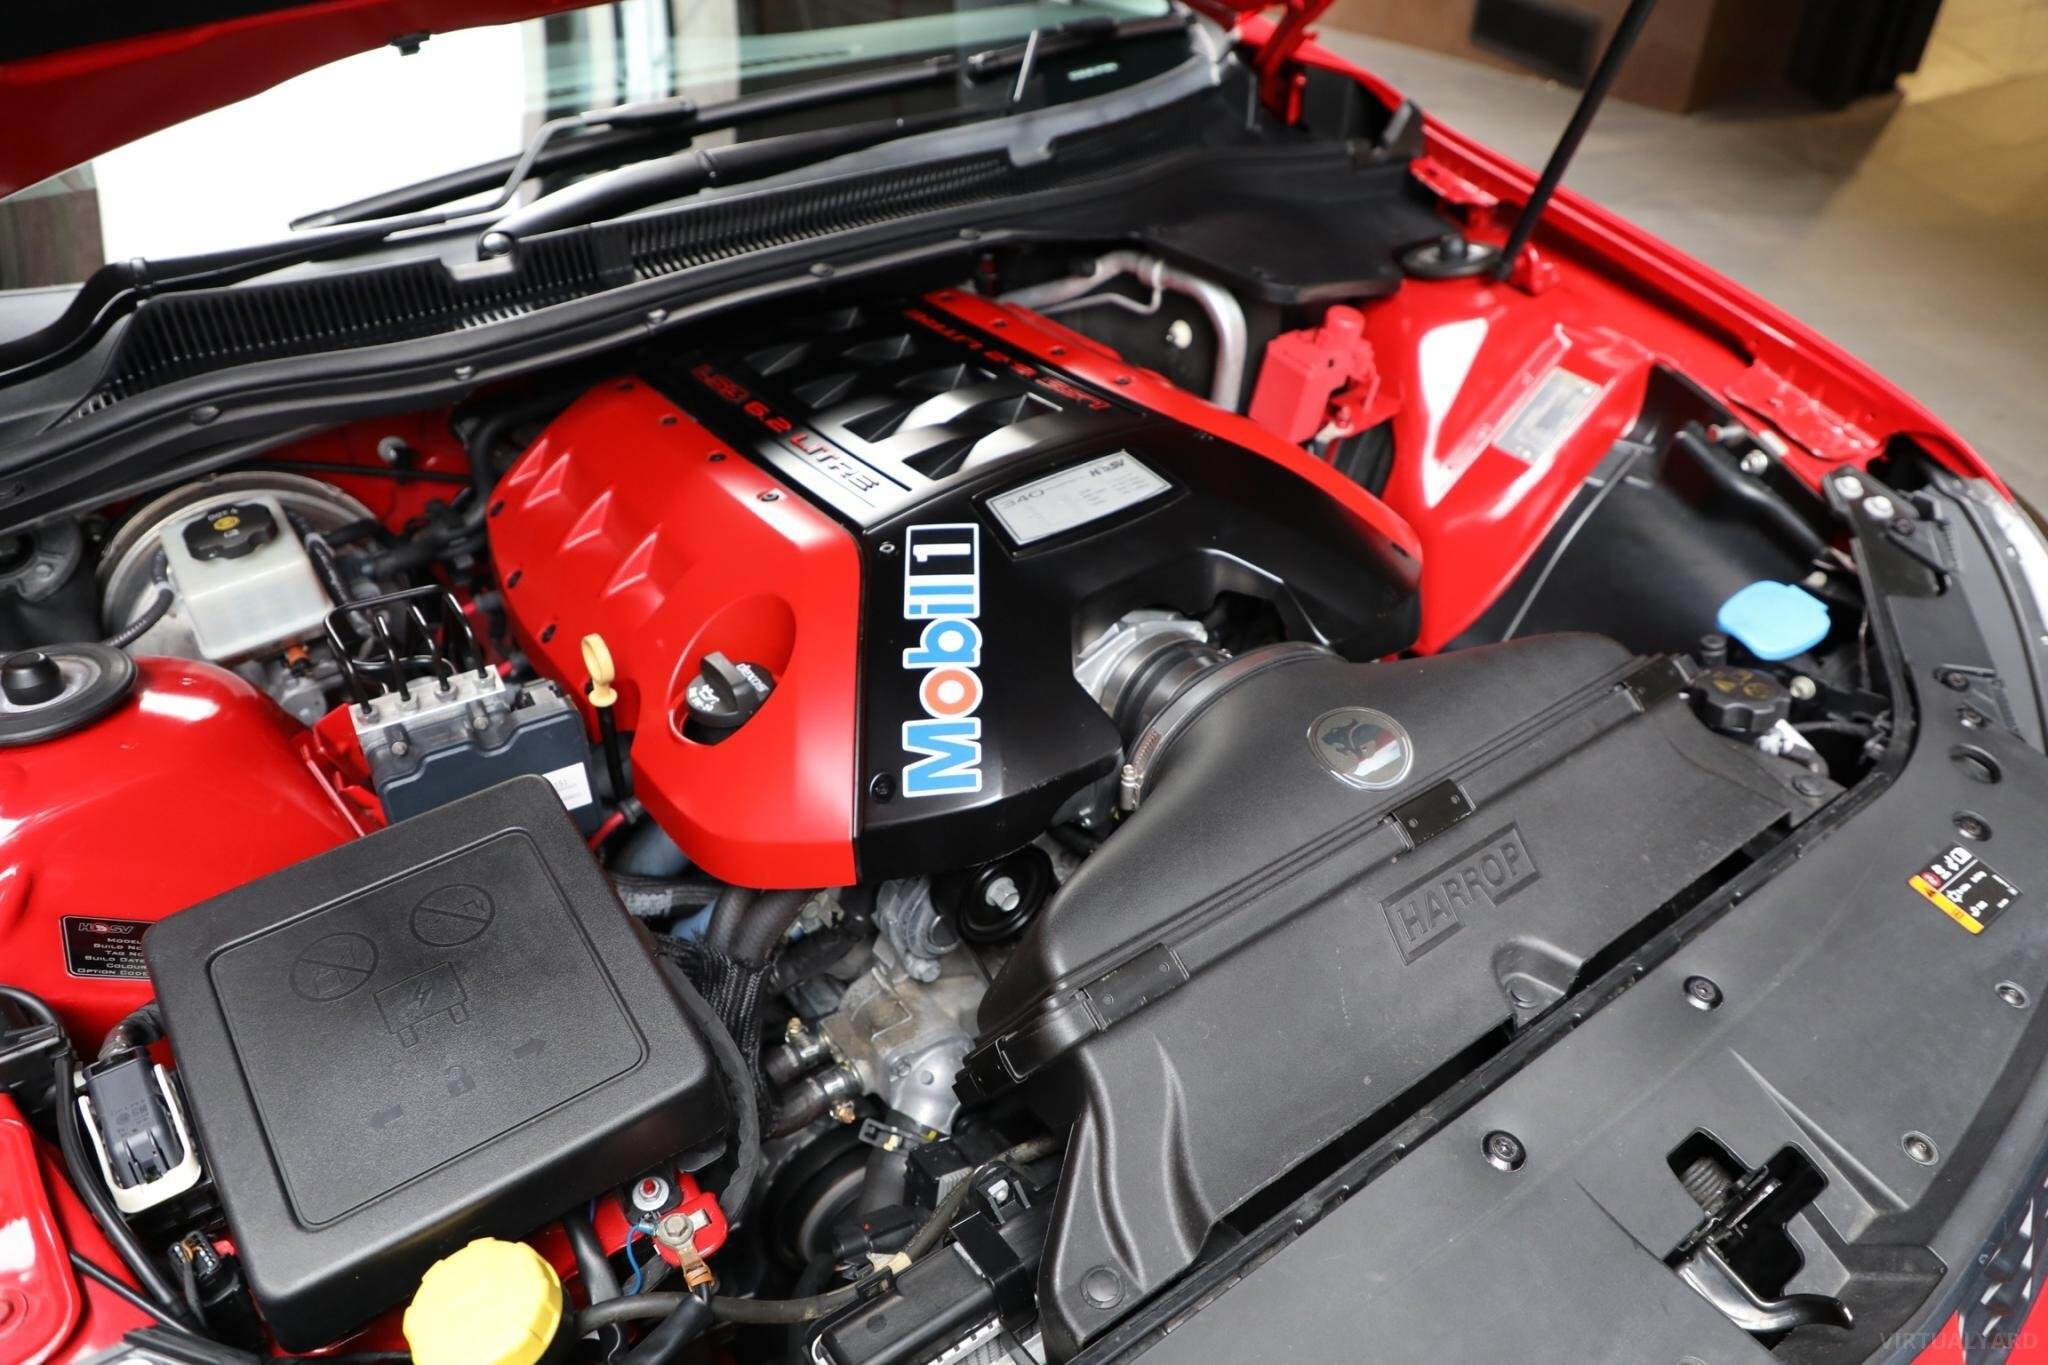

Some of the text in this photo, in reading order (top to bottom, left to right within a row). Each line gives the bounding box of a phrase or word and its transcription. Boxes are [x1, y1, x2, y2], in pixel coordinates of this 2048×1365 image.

[790, 432, 879, 491] LITRE
[903, 578, 982, 797] Mobil
[1397, 841, 1521, 944] HARROP
